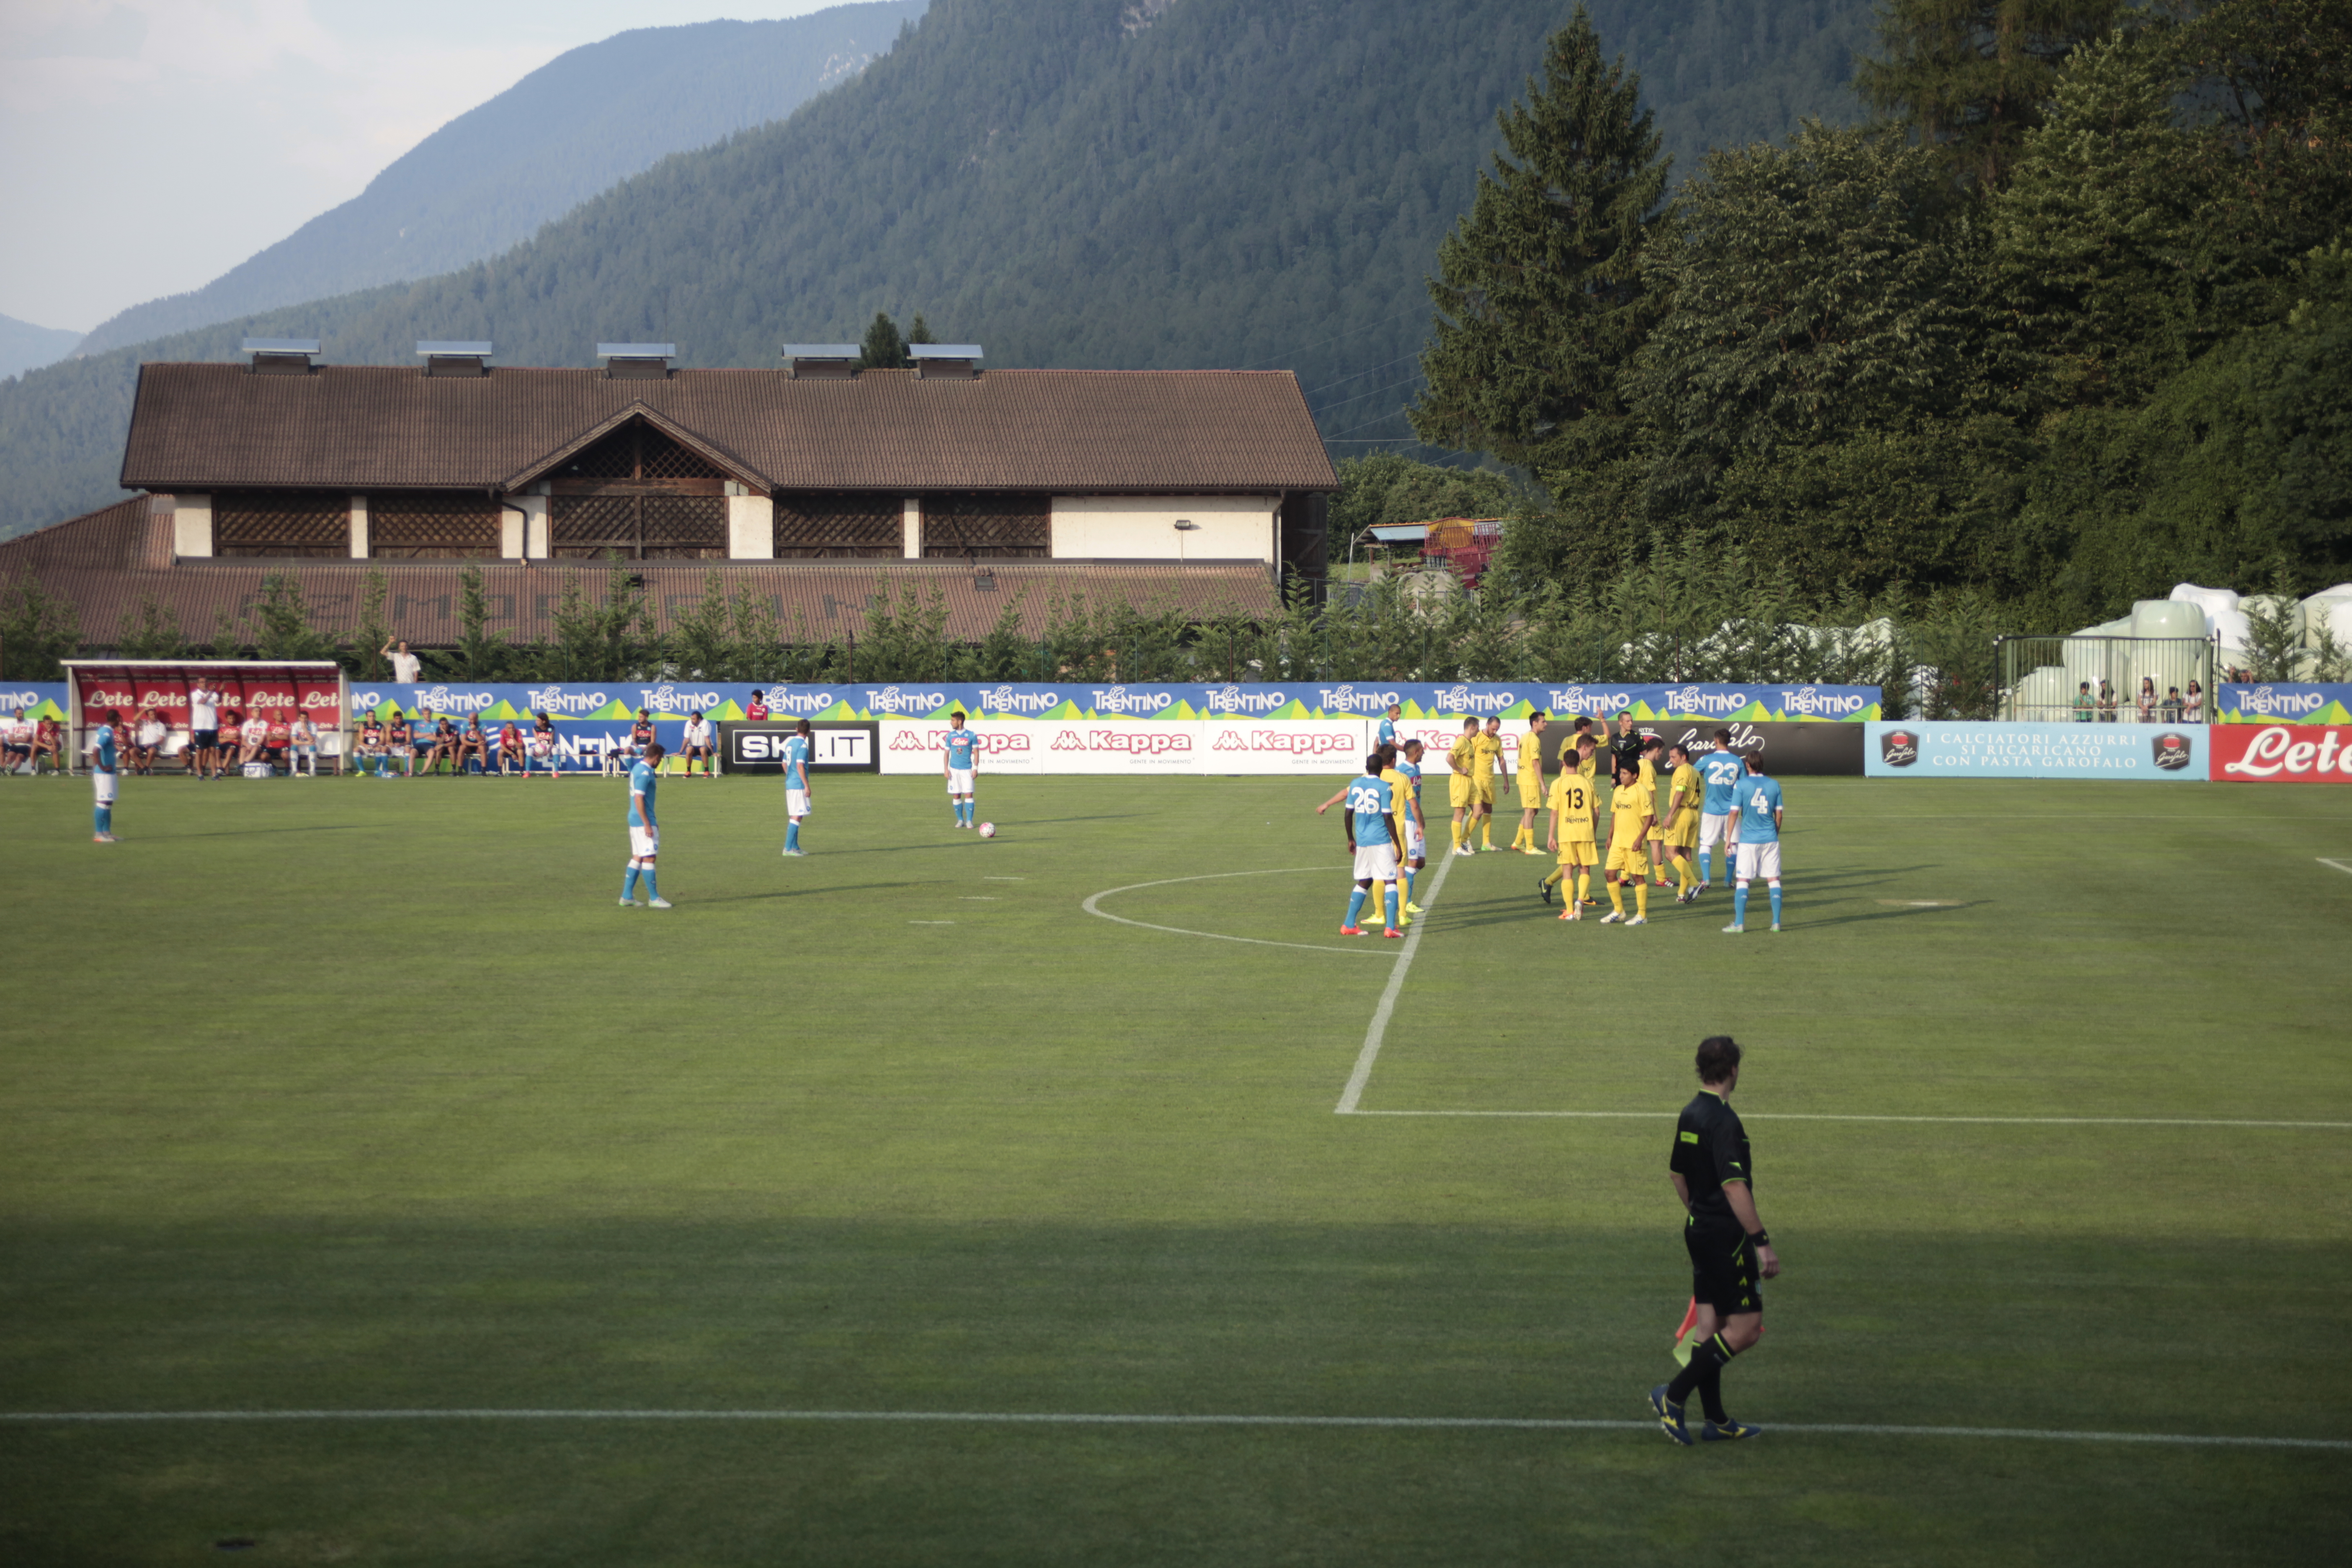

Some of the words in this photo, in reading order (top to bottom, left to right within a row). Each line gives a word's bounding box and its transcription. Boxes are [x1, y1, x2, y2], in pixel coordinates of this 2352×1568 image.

[85, 691, 133, 707] Lete
[138, 691, 187, 707] Lete
[214, 692, 241, 707] te
[245, 691, 295, 708] Lete
[299, 691, 340, 708] Let
[415, 690, 493, 712] TRENTINO
[528, 691, 606, 712] TRENTINO
[641, 690, 720, 711] TRENTINO
[762, 691, 832, 712] RENTINO
[867, 691, 944, 712] TRENTINO
[979, 690, 1058, 712] TRENTINO
[1093, 691, 1171, 712] TRENTINO
[1206, 690, 1285, 712] TRENTINO
[1320, 690, 1399, 711] TRENTINO
[1434, 690, 1514, 712] TRENTINO
[1550, 691, 1630, 713] TRENTINO
[1665, 691, 1746, 712] TRENTINO
[1782, 692, 1863, 714] TRENTINO
[2237, 691, 2323, 713] TRENTINO
[742, 736, 864, 758] SK.IT
[1090, 731, 1191, 753] Kappa
[1252, 731, 1354, 753] Kappa
[1417, 730, 1519, 750] Kaa
[1927, 734, 1930, 743] I
[1941, 734, 2049, 744] CALCIATORI
[2059, 735, 2135, 745] AZZURRI
[1884, 747, 1916, 762] Garofalo
[1962, 745, 1975, 754] SI
[1987, 745, 2101, 756] RICARICANO
[2156, 750, 2188, 765] Garofalo
[1933, 756, 1970, 766] CON
[1982, 756, 2032, 766] PASTA
[2042, 757, 2136, 767] GAROFALO
[1708, 761, 1738, 784] 23
[1695, 777, 1700, 797] 4
[1351, 787, 1380, 814] 26
[1566, 788, 1583, 809] 13
[1750, 788, 1768, 814] 4
